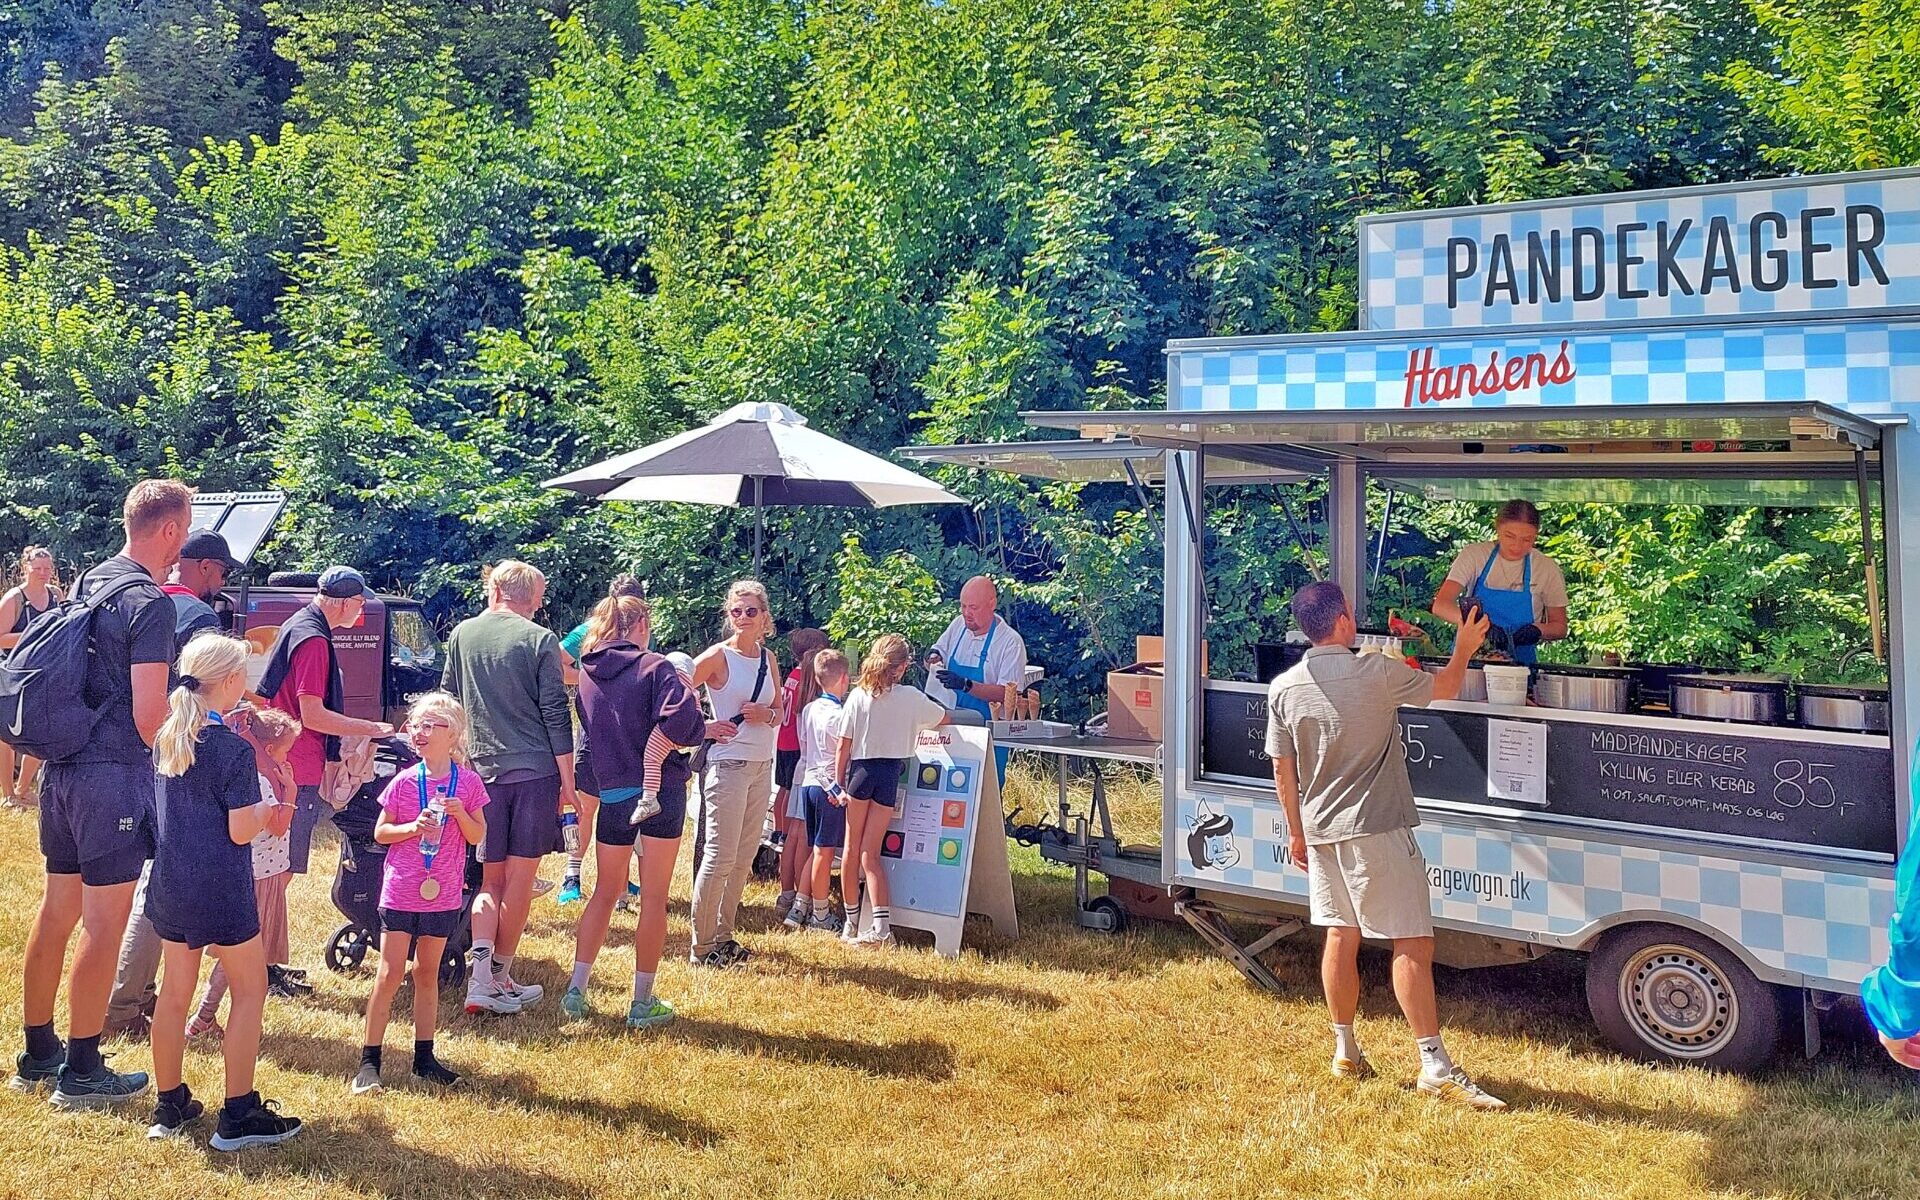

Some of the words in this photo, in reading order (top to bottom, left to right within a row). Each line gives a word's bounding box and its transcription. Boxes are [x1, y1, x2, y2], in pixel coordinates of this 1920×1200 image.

[1448, 205, 1890, 309] PANDEKAGER
[1404, 339, 1577, 408] Hansens
[1246, 700, 1269, 716] MA
[1592, 730, 1747, 764] MADPANDEKAGER
[1600, 760, 1656, 783] KYLLING
[1667, 768, 1703, 788] ELLER
[1710, 774, 1756, 794] KEBAB
[1712, 802, 1742, 816] MAJS
[1271, 817, 1283, 839] lej
